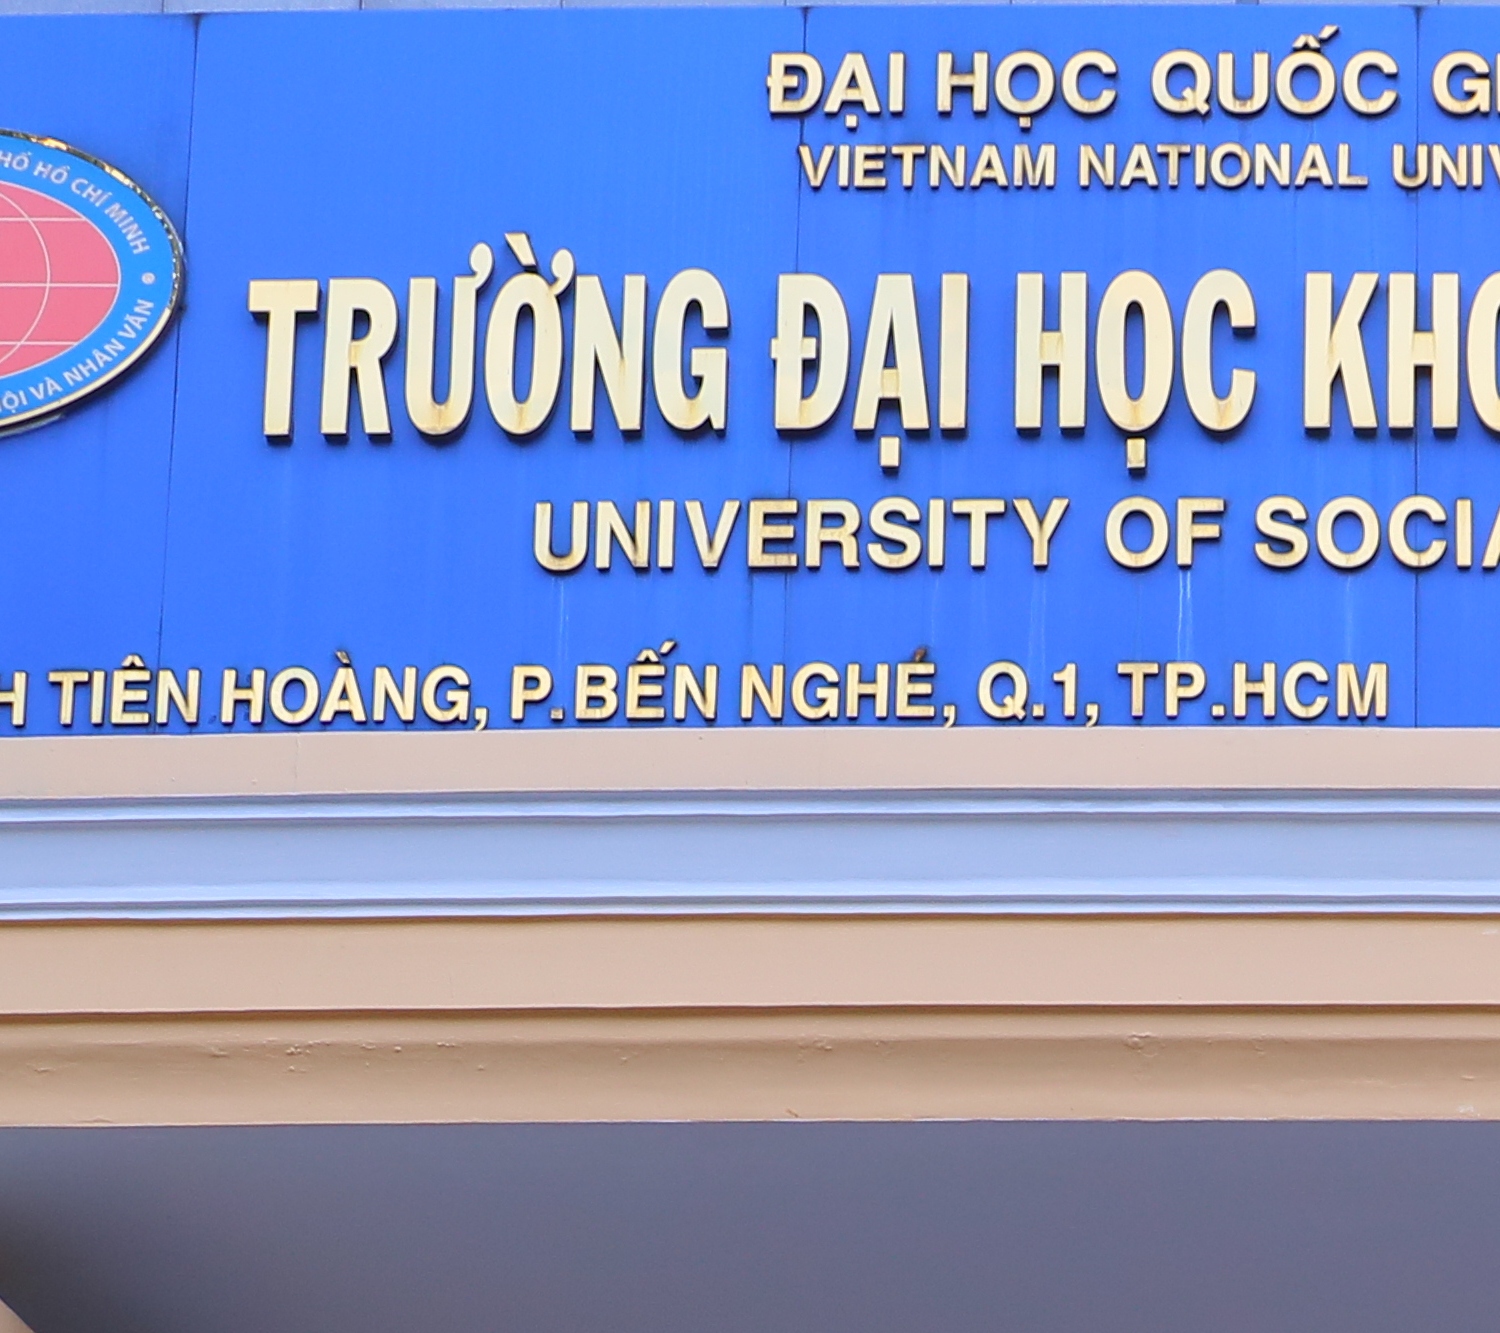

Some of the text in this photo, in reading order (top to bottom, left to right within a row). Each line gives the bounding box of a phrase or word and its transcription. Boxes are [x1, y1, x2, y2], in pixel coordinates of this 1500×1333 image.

[765, 51, 907, 130] ĐẠI
[936, 49, 1119, 130] HỌC
[1150, 23, 1400, 118] QUỐC
[34, 159, 70, 185] HỒ
[69, 177, 111, 207] CHÍ
[105, 202, 150, 255] MINH
[797, 142, 1058, 190] VIETNAM
[1078, 141, 1369, 189] NATIONAL
[29, 375, 62, 402] VÀ
[62, 340, 124, 393] NHÂN
[118, 298, 154, 351] VĂN
[246, 231, 731, 443] TRƯỜNG
[769, 271, 971, 470] ĐẠI
[1013, 267, 1258, 472] HỌC
[533, 495, 1071, 575] UNIVERSITY
[1104, 495, 1227, 571] OF
[49, 653, 200, 727] TIÊN
[221, 651, 490, 731] HOÀNG,
[509, 641, 718, 722] P.BẾN
[741, 646, 956, 730] NGHÉ,
[976, 662, 1100, 730] Q.1,
[1117, 661, 1389, 720] TP.HCM
